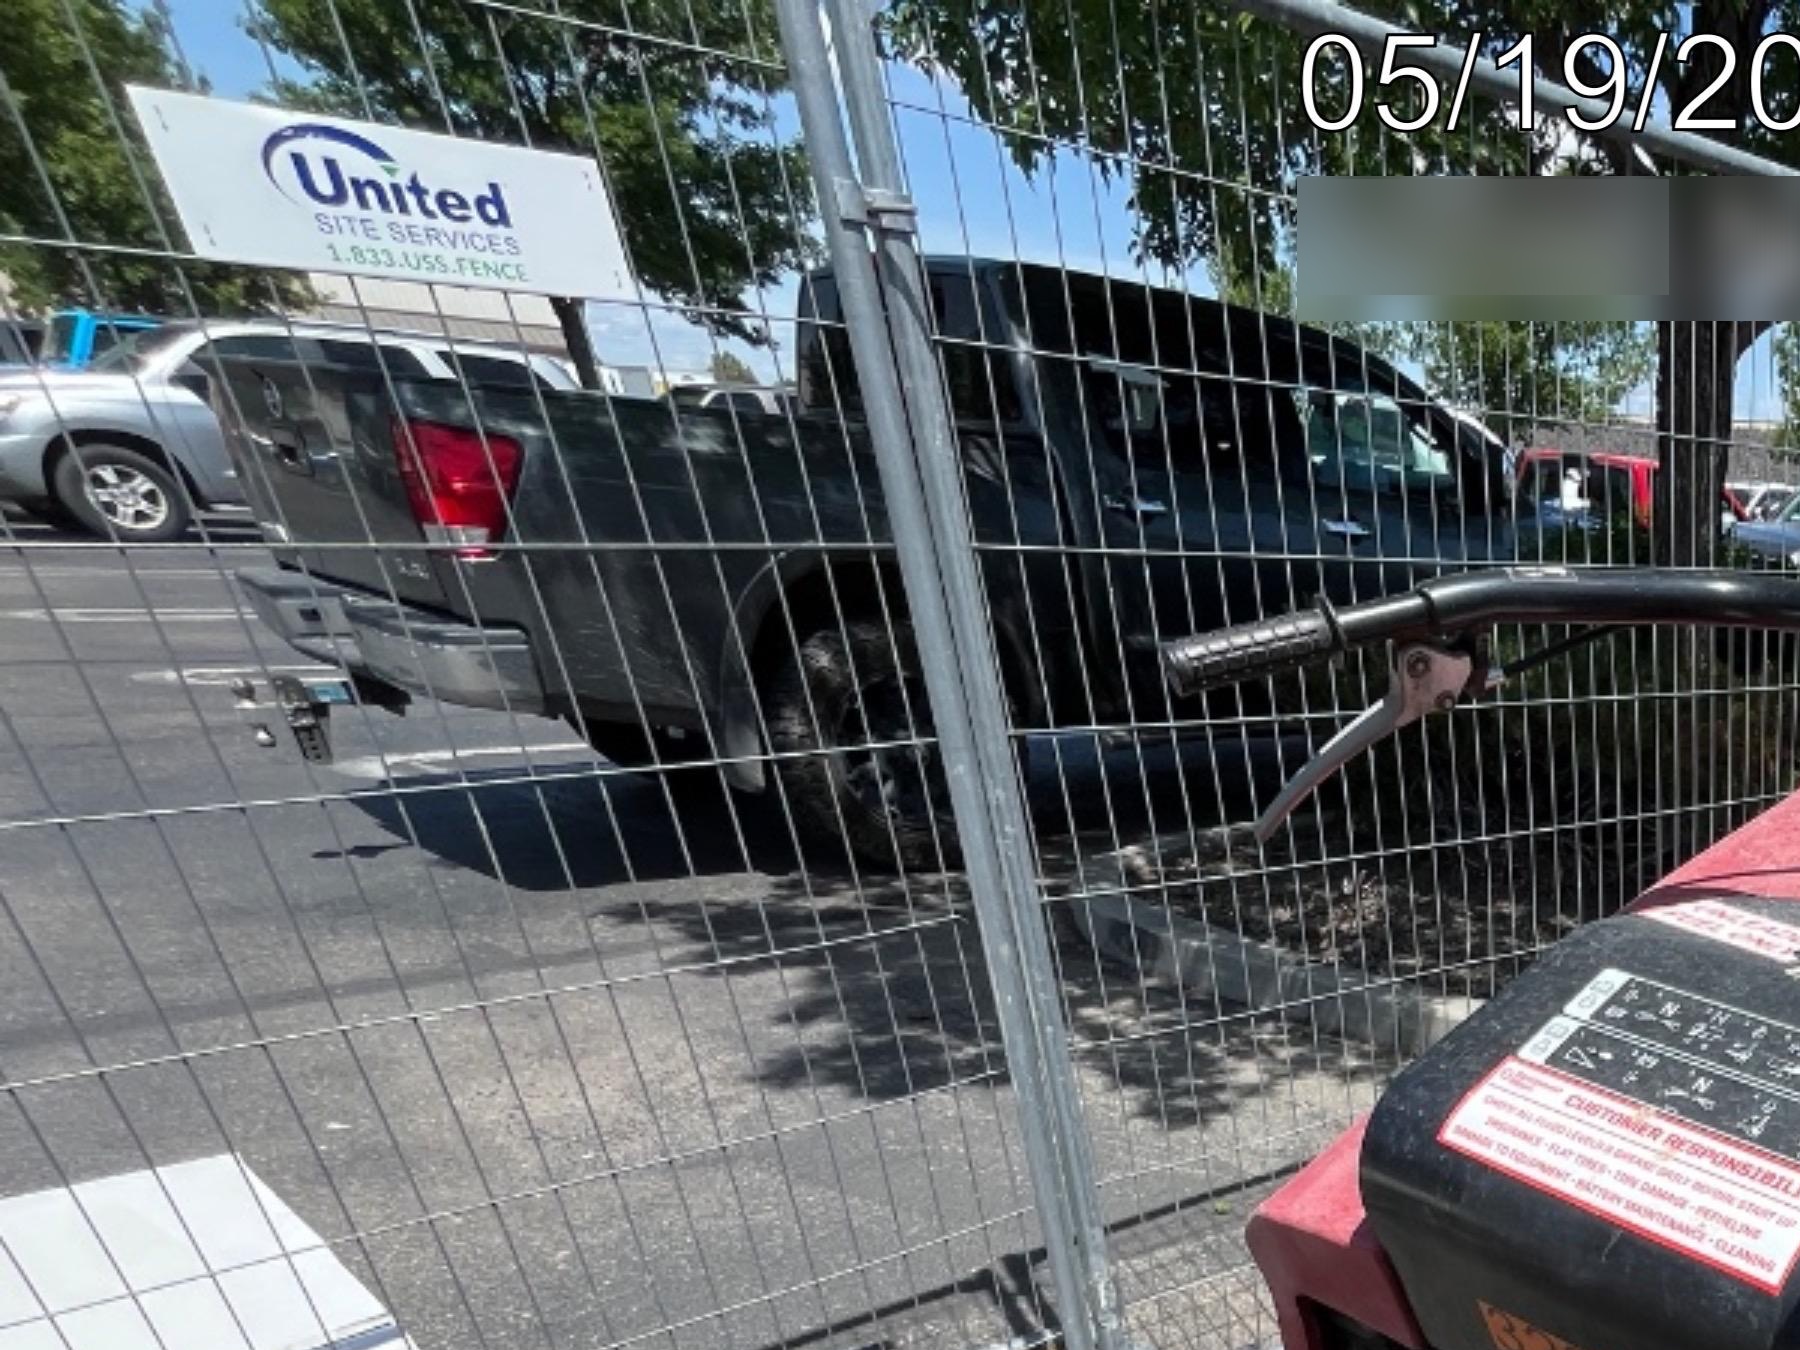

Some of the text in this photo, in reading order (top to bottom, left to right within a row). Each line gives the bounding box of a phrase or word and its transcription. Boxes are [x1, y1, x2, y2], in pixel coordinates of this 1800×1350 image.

[290, 152, 512, 228] United
[315, 213, 522, 256] SITE SERVICES
[326, 242, 529, 282] 1.833.USS.FENCE
[1564, 1094, 1662, 1140] CUSTOMER
